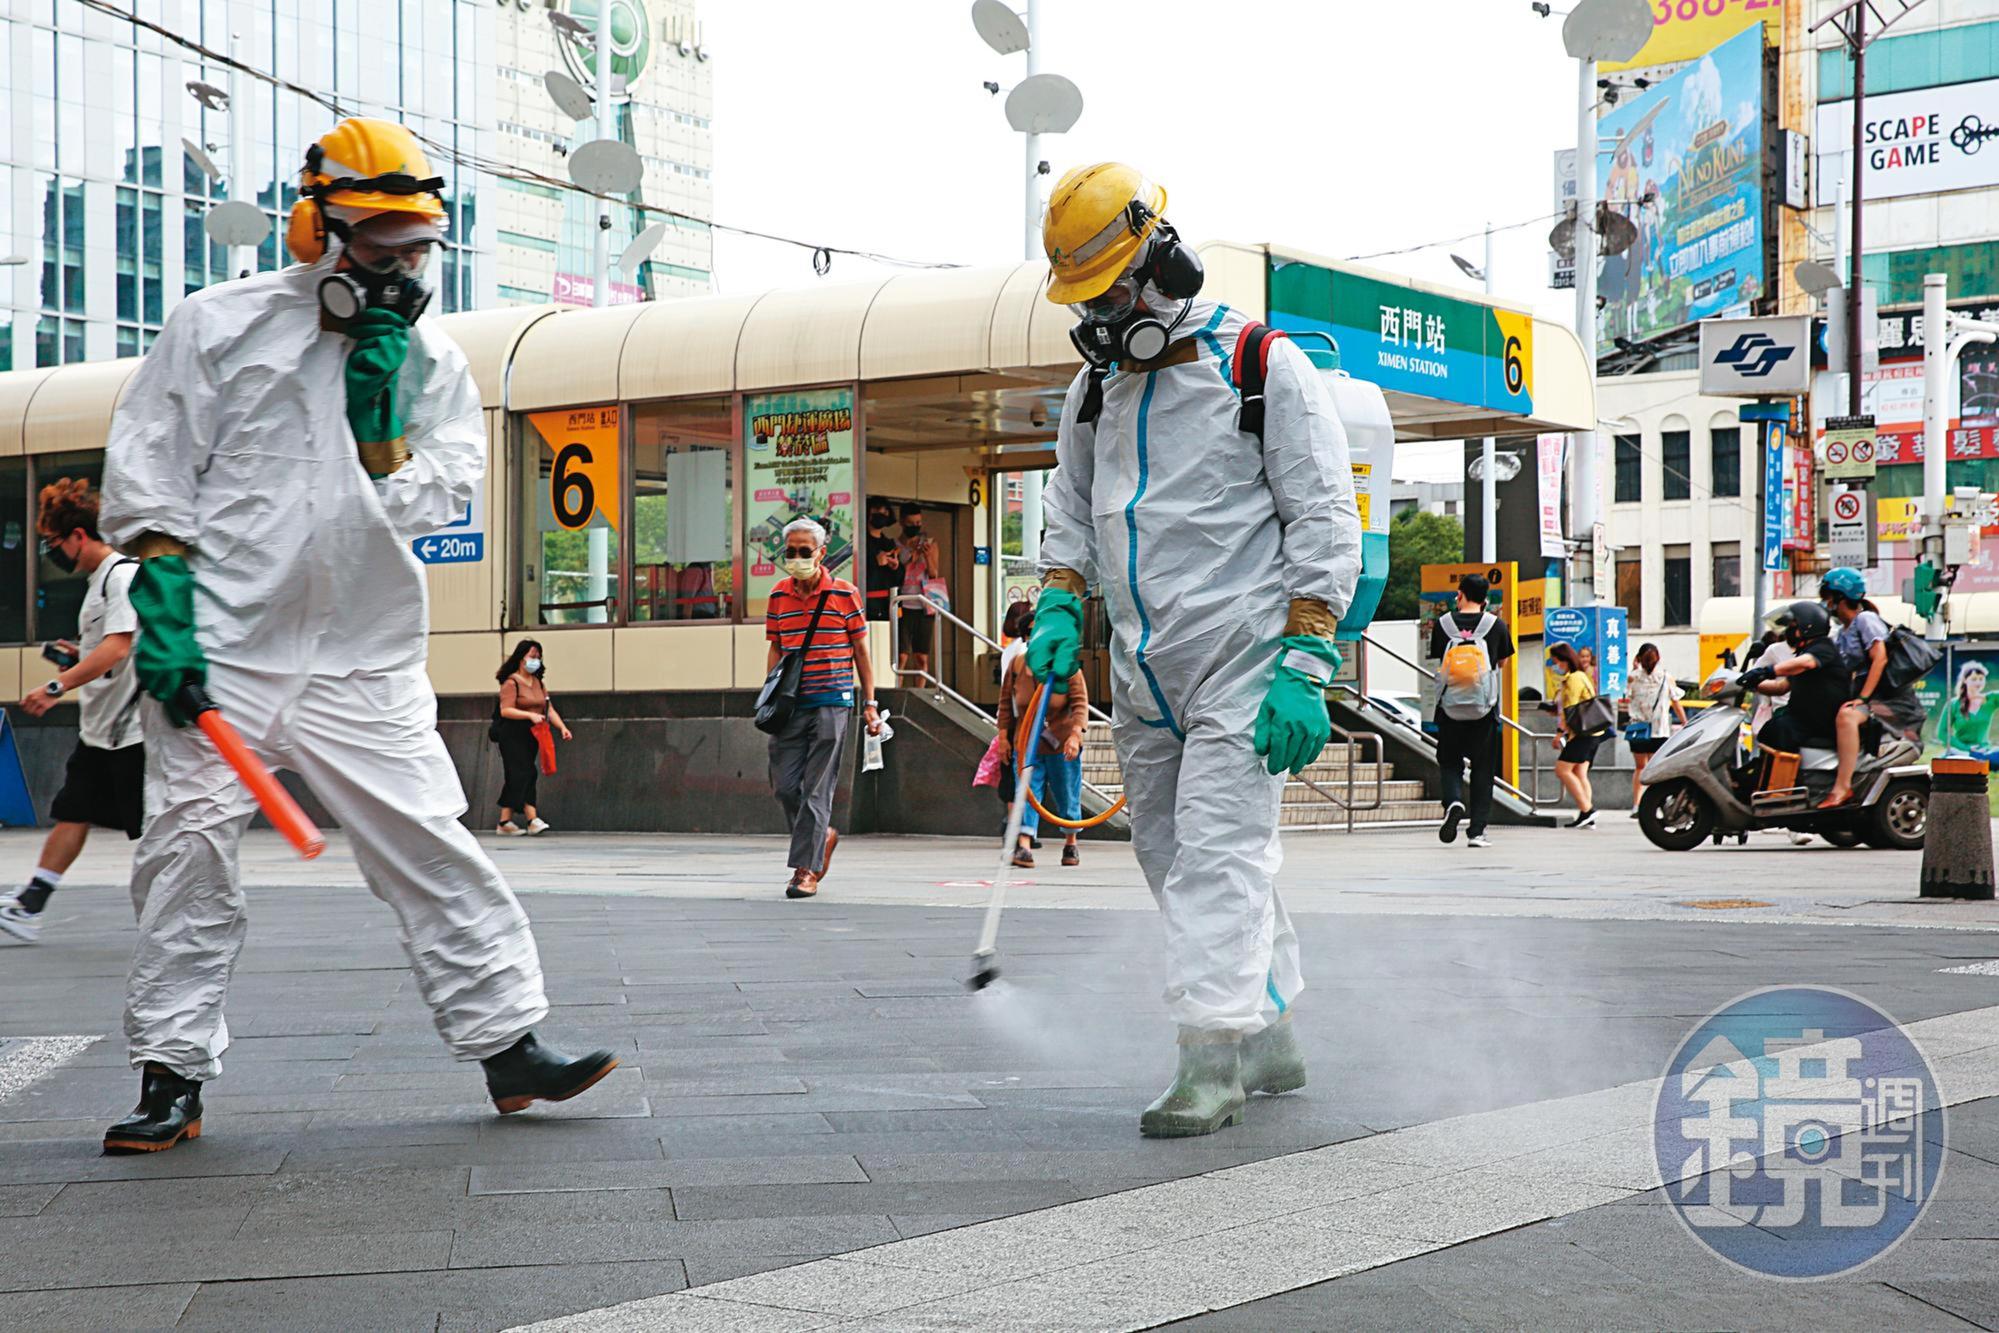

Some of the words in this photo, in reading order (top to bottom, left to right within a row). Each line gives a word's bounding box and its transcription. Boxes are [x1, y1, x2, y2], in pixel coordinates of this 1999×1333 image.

[1864, 113, 1940, 144] SCAPE
[1870, 142, 1940, 171] GAME
[1379, 305, 1446, 355] 西門站
[1378, 351, 1408, 371] XIMEN
[1409, 358, 1448, 379] STATION
[1505, 336, 1523, 394] 6
[552, 442, 595, 528] 6
[968, 478, 981, 507] 6
[440, 538, 476, 558] 20m
